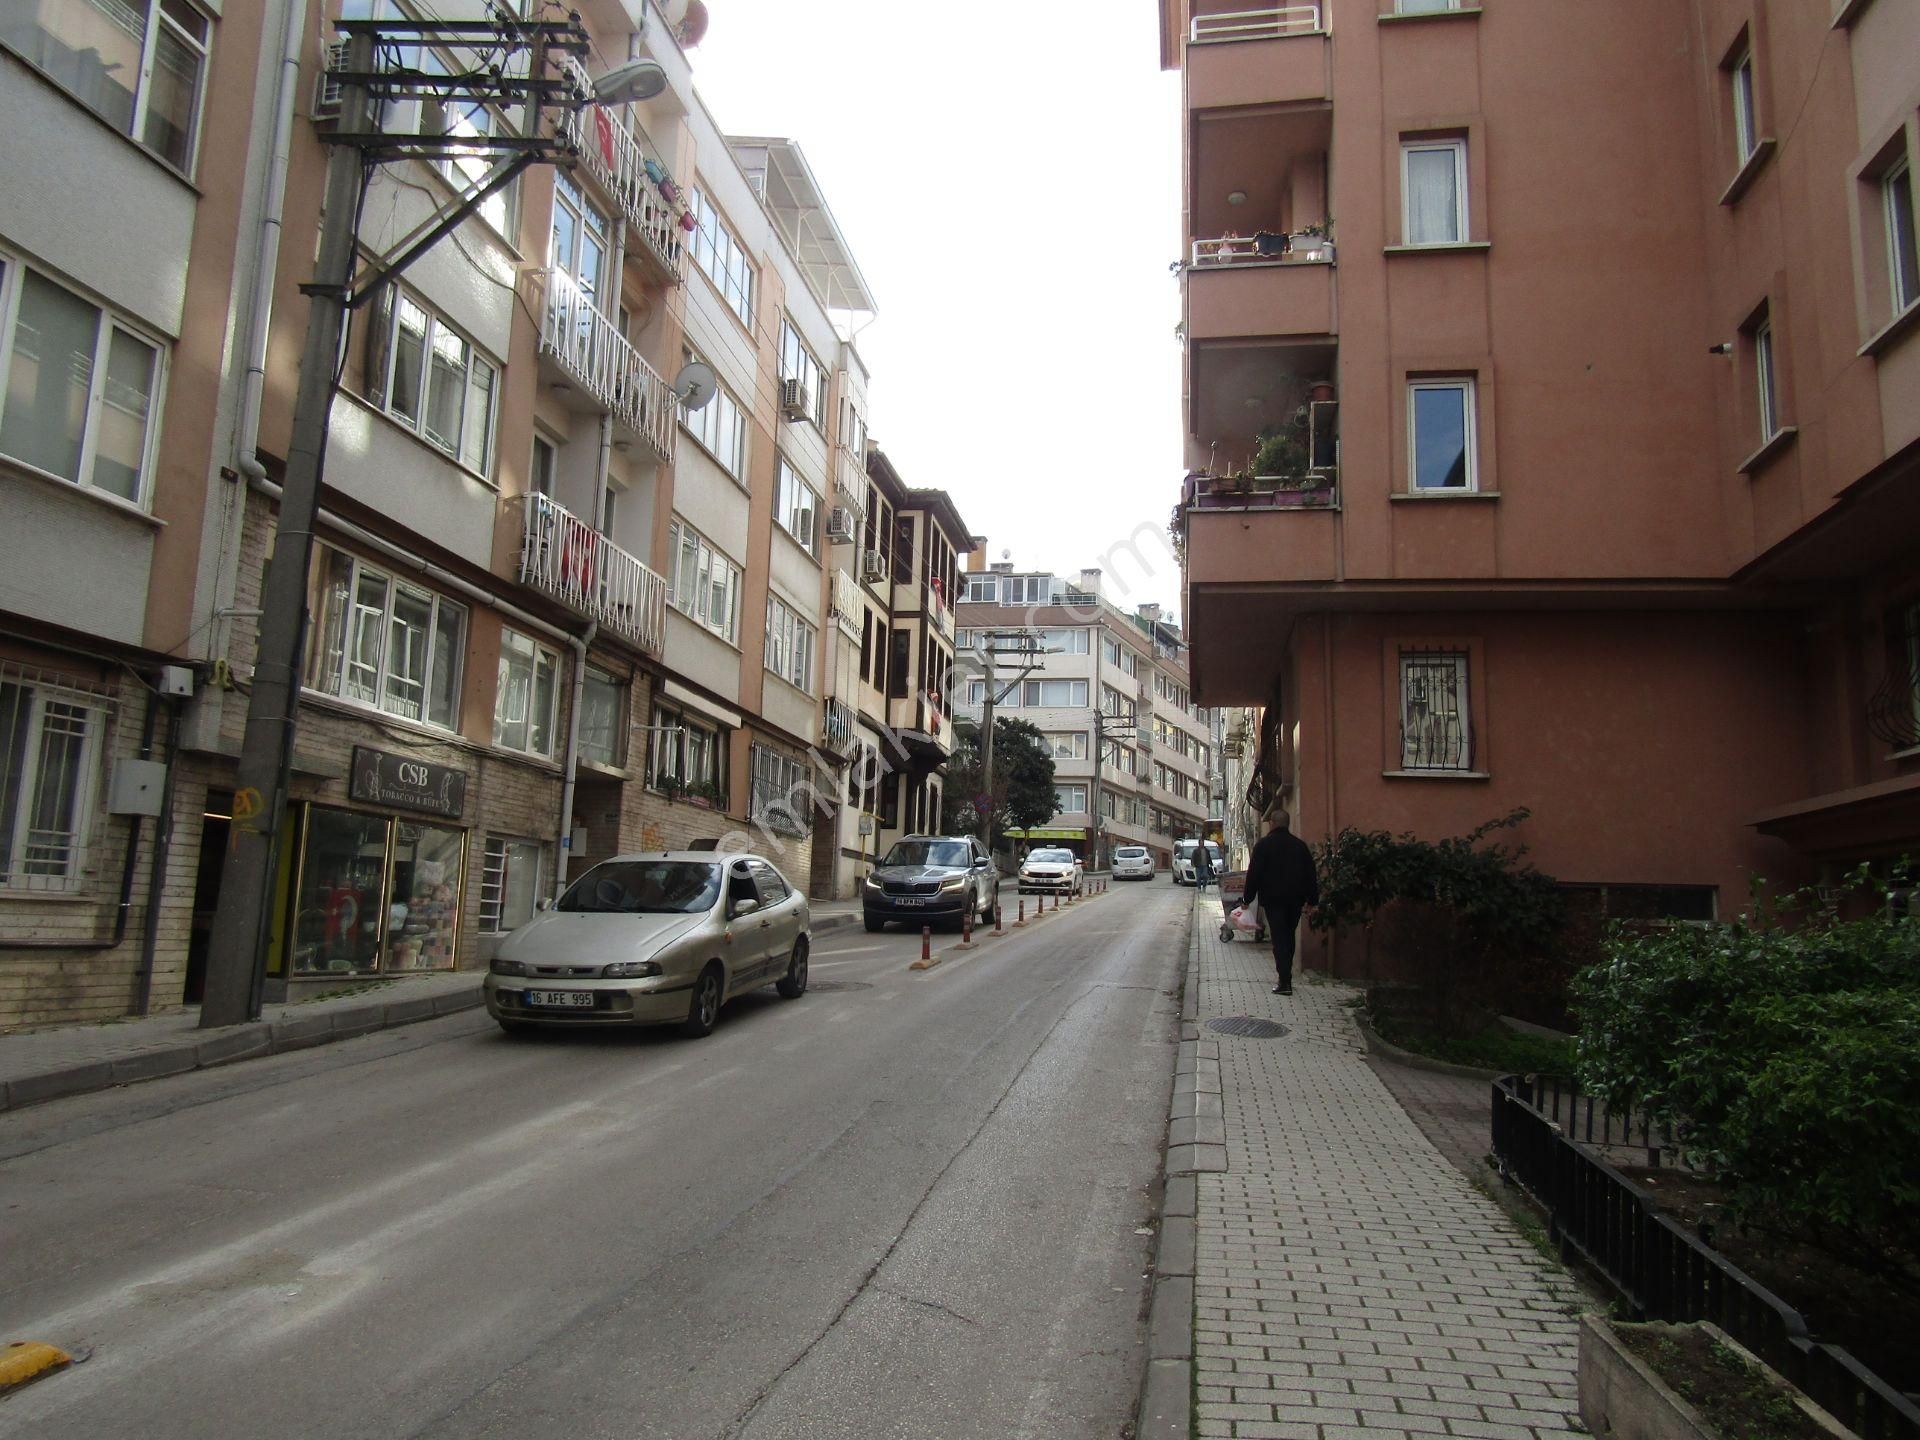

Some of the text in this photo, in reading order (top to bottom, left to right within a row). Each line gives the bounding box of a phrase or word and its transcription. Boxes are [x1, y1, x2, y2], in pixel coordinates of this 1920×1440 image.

[398, 762, 428, 787] CSB
[381, 789, 415, 804] TOBACCO
[532, 992, 592, 1005] 16 AFE 995
